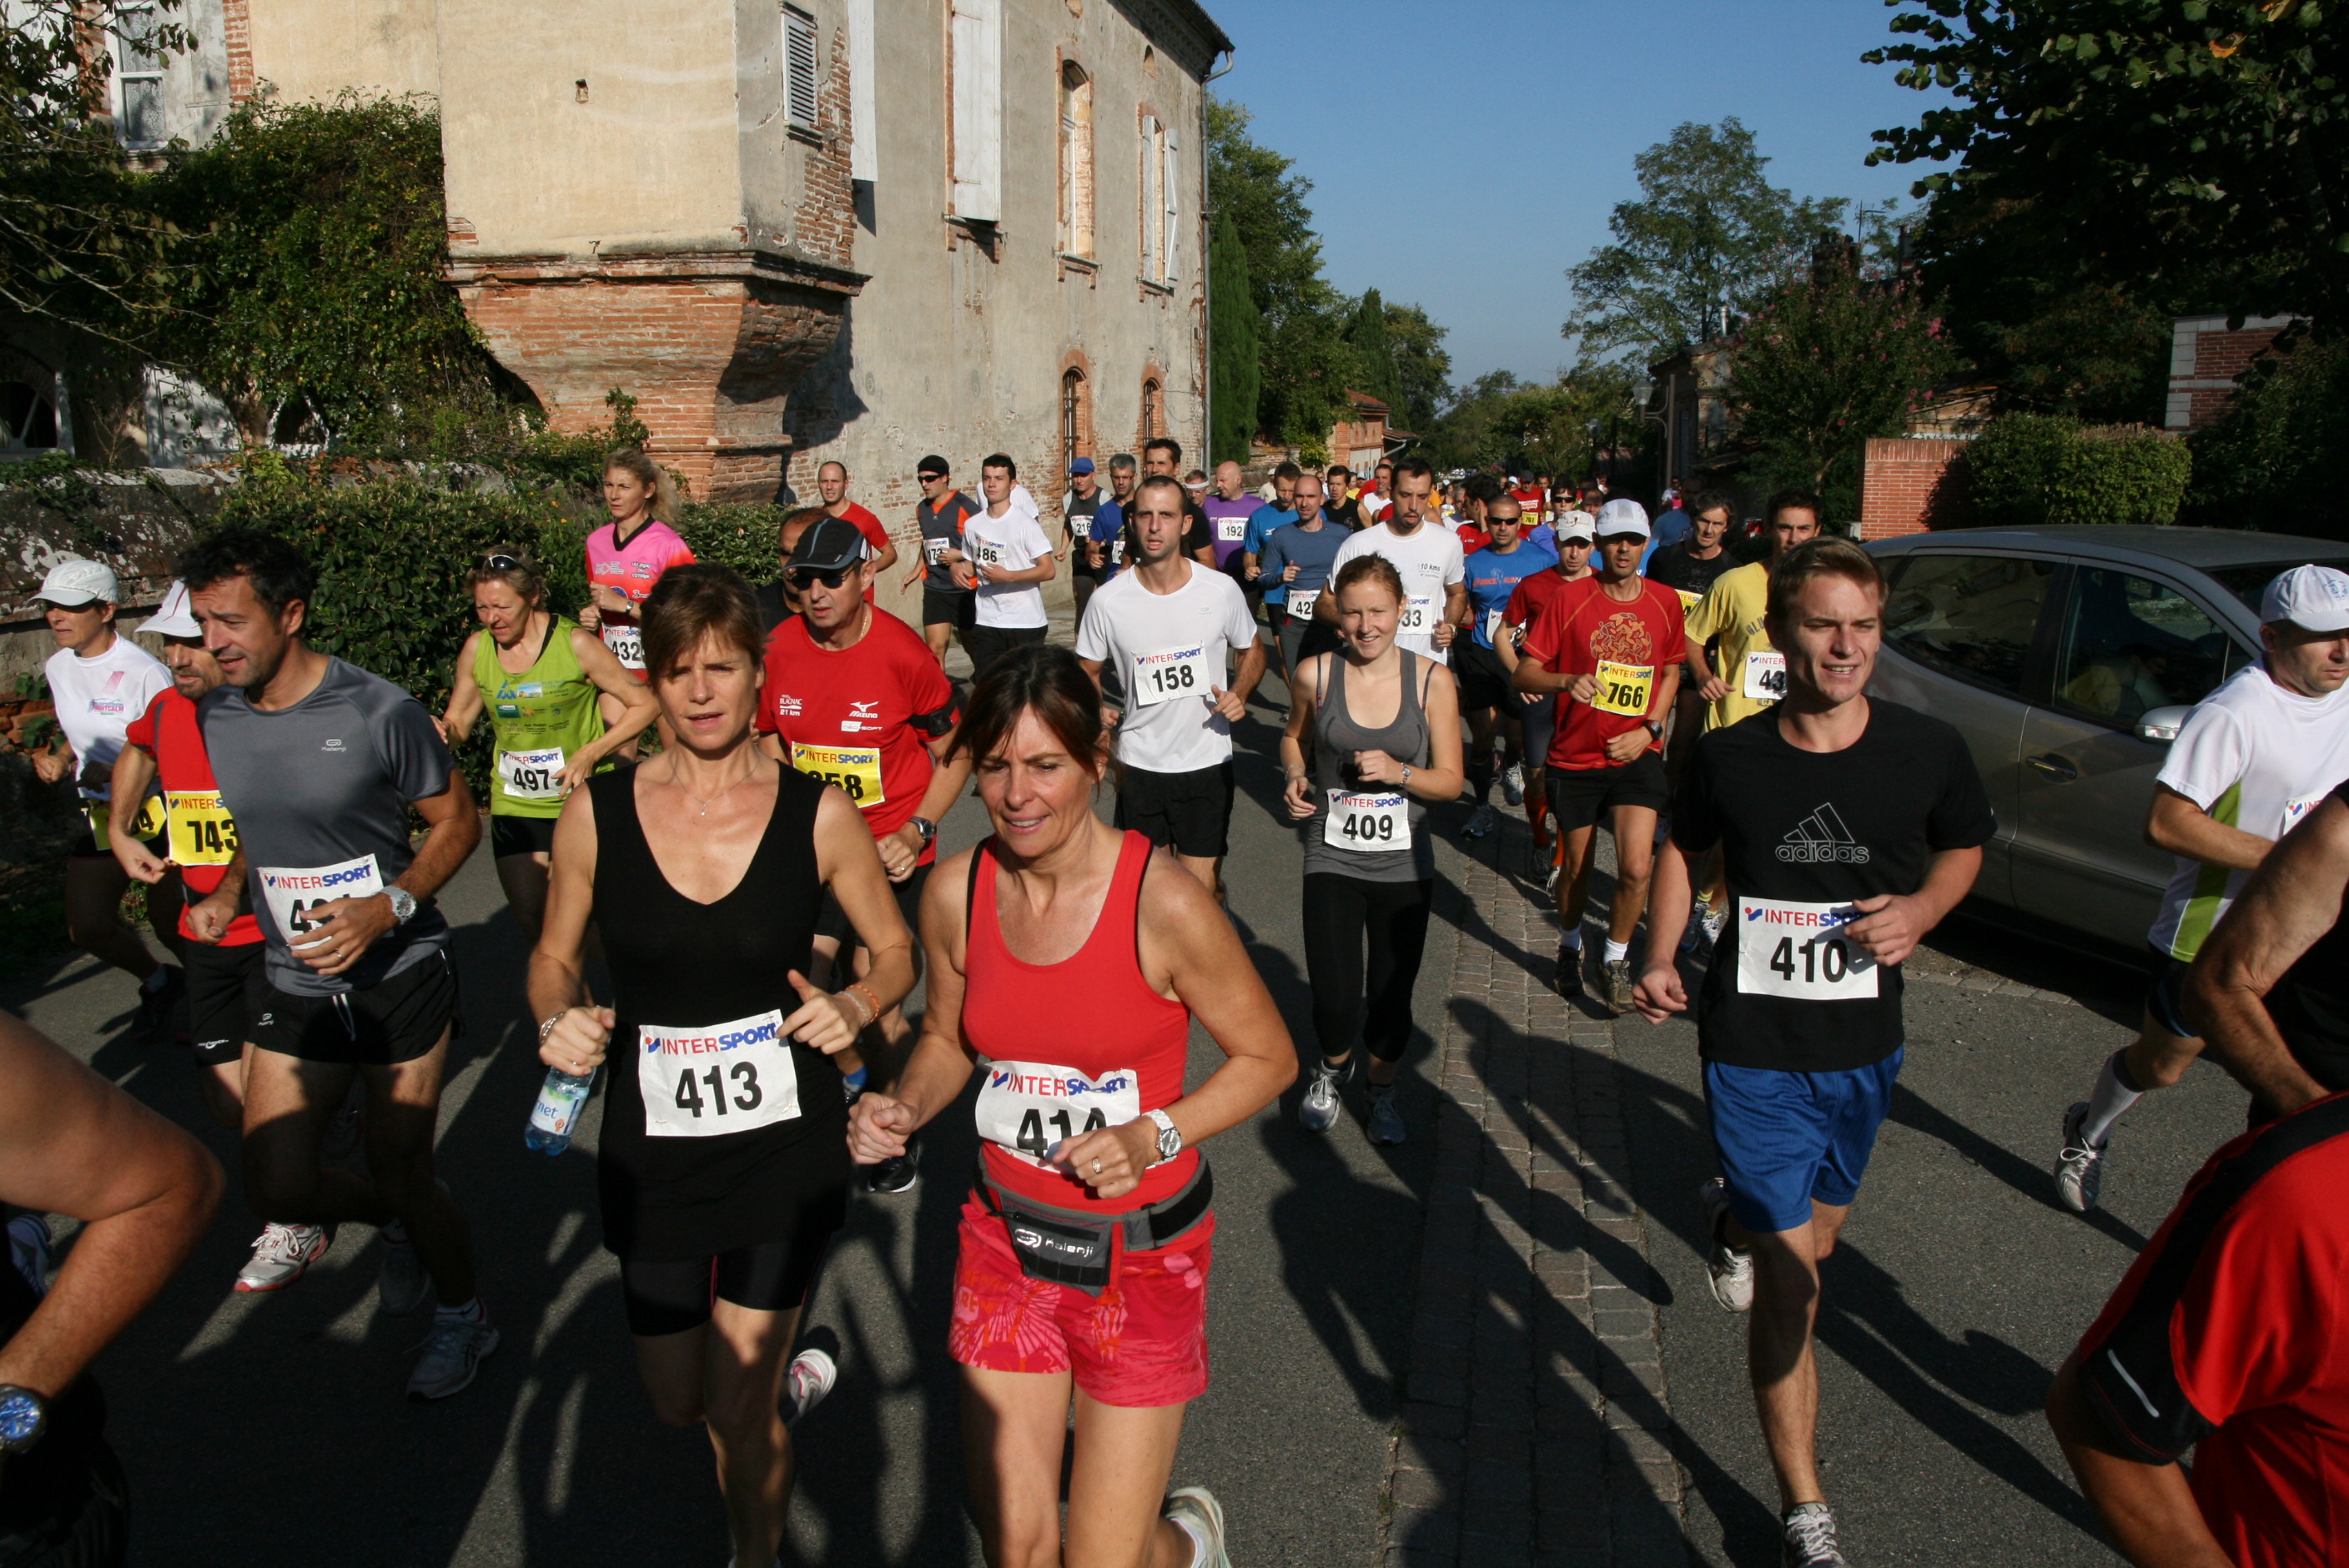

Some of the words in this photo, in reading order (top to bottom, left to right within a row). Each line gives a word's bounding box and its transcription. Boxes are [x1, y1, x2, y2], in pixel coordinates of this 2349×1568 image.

[1076, 522, 1091, 533] 216
[1225, 525, 1243, 537] 192
[1295, 601, 1315, 615] 42
[1401, 609, 1421, 627] 33
[611, 641, 641, 661] 432
[1145, 647, 1201, 665] INTERSPORT
[1152, 665, 1195, 692] 158
[1608, 667, 1652, 679] INTERSPORT
[1607, 682, 1644, 709] 766
[806, 750, 874, 764] INTERSPORT
[514, 767, 550, 792] 497
[1341, 796, 1406, 808] INTERSPORT
[187, 818, 239, 853] 743
[1343, 813, 1393, 842] 409
[1775, 841, 1870, 864] adidas
[277, 864, 373, 890] INTERSPORT
[1770, 936, 1849, 983] 410
[661, 1023, 777, 1055] INTERSPORT
[675, 1061, 763, 1118] 413
[1045, 1237, 1094, 1258] Kalenji
